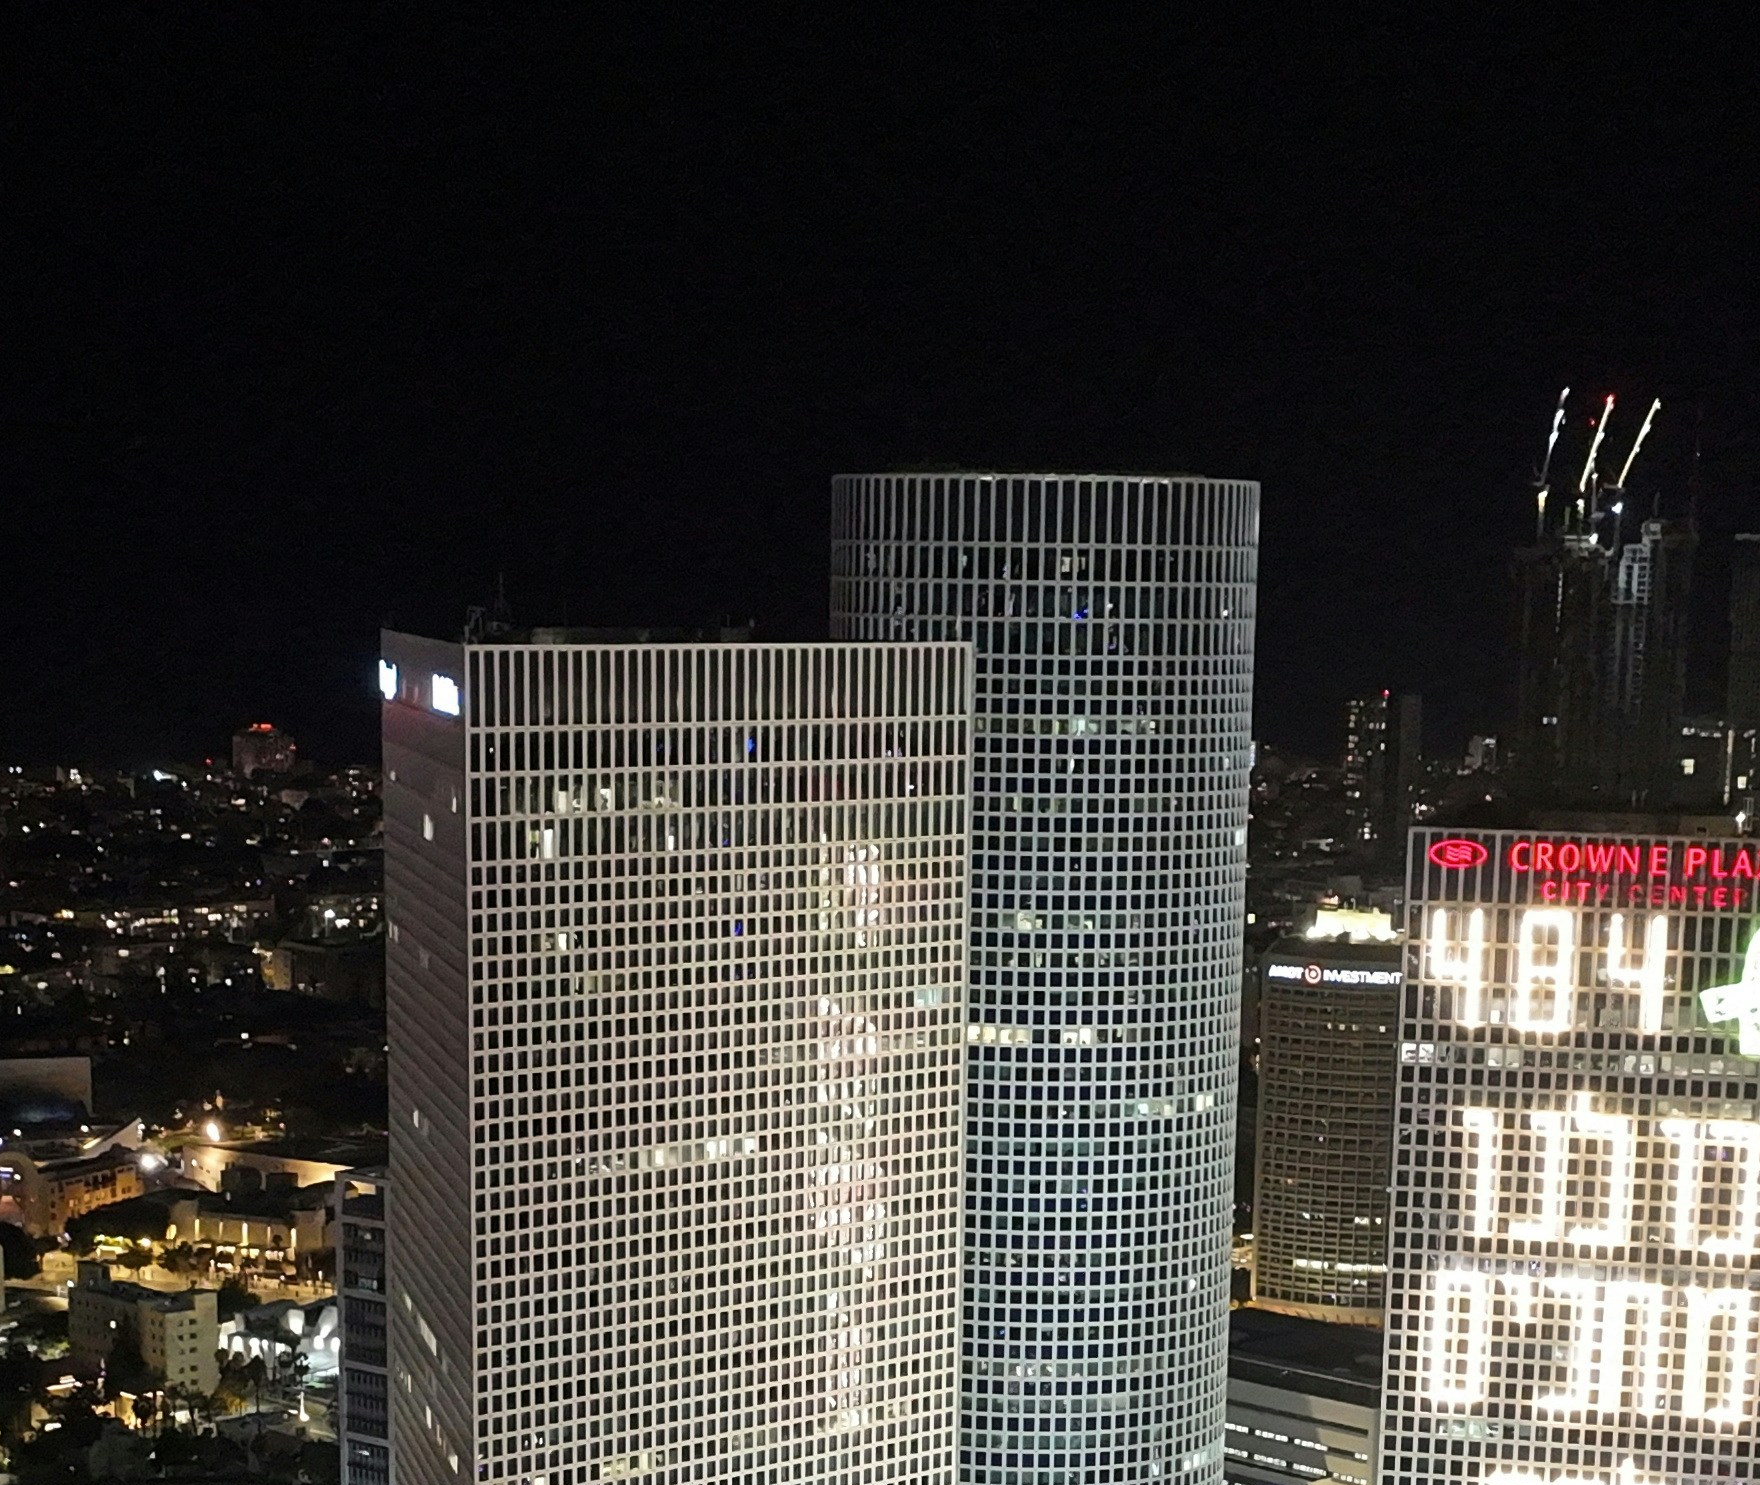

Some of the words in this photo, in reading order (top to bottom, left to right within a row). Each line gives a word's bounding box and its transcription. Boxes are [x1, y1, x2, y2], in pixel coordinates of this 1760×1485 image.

[1509, 841, 1669, 877] CROWNE
[1540, 881, 1609, 902] CITY
[1628, 884, 1748, 908] CENTER
[1430, 907, 1669, 1034] 484
[1427, 1267, 1755, 1426] מחכים
